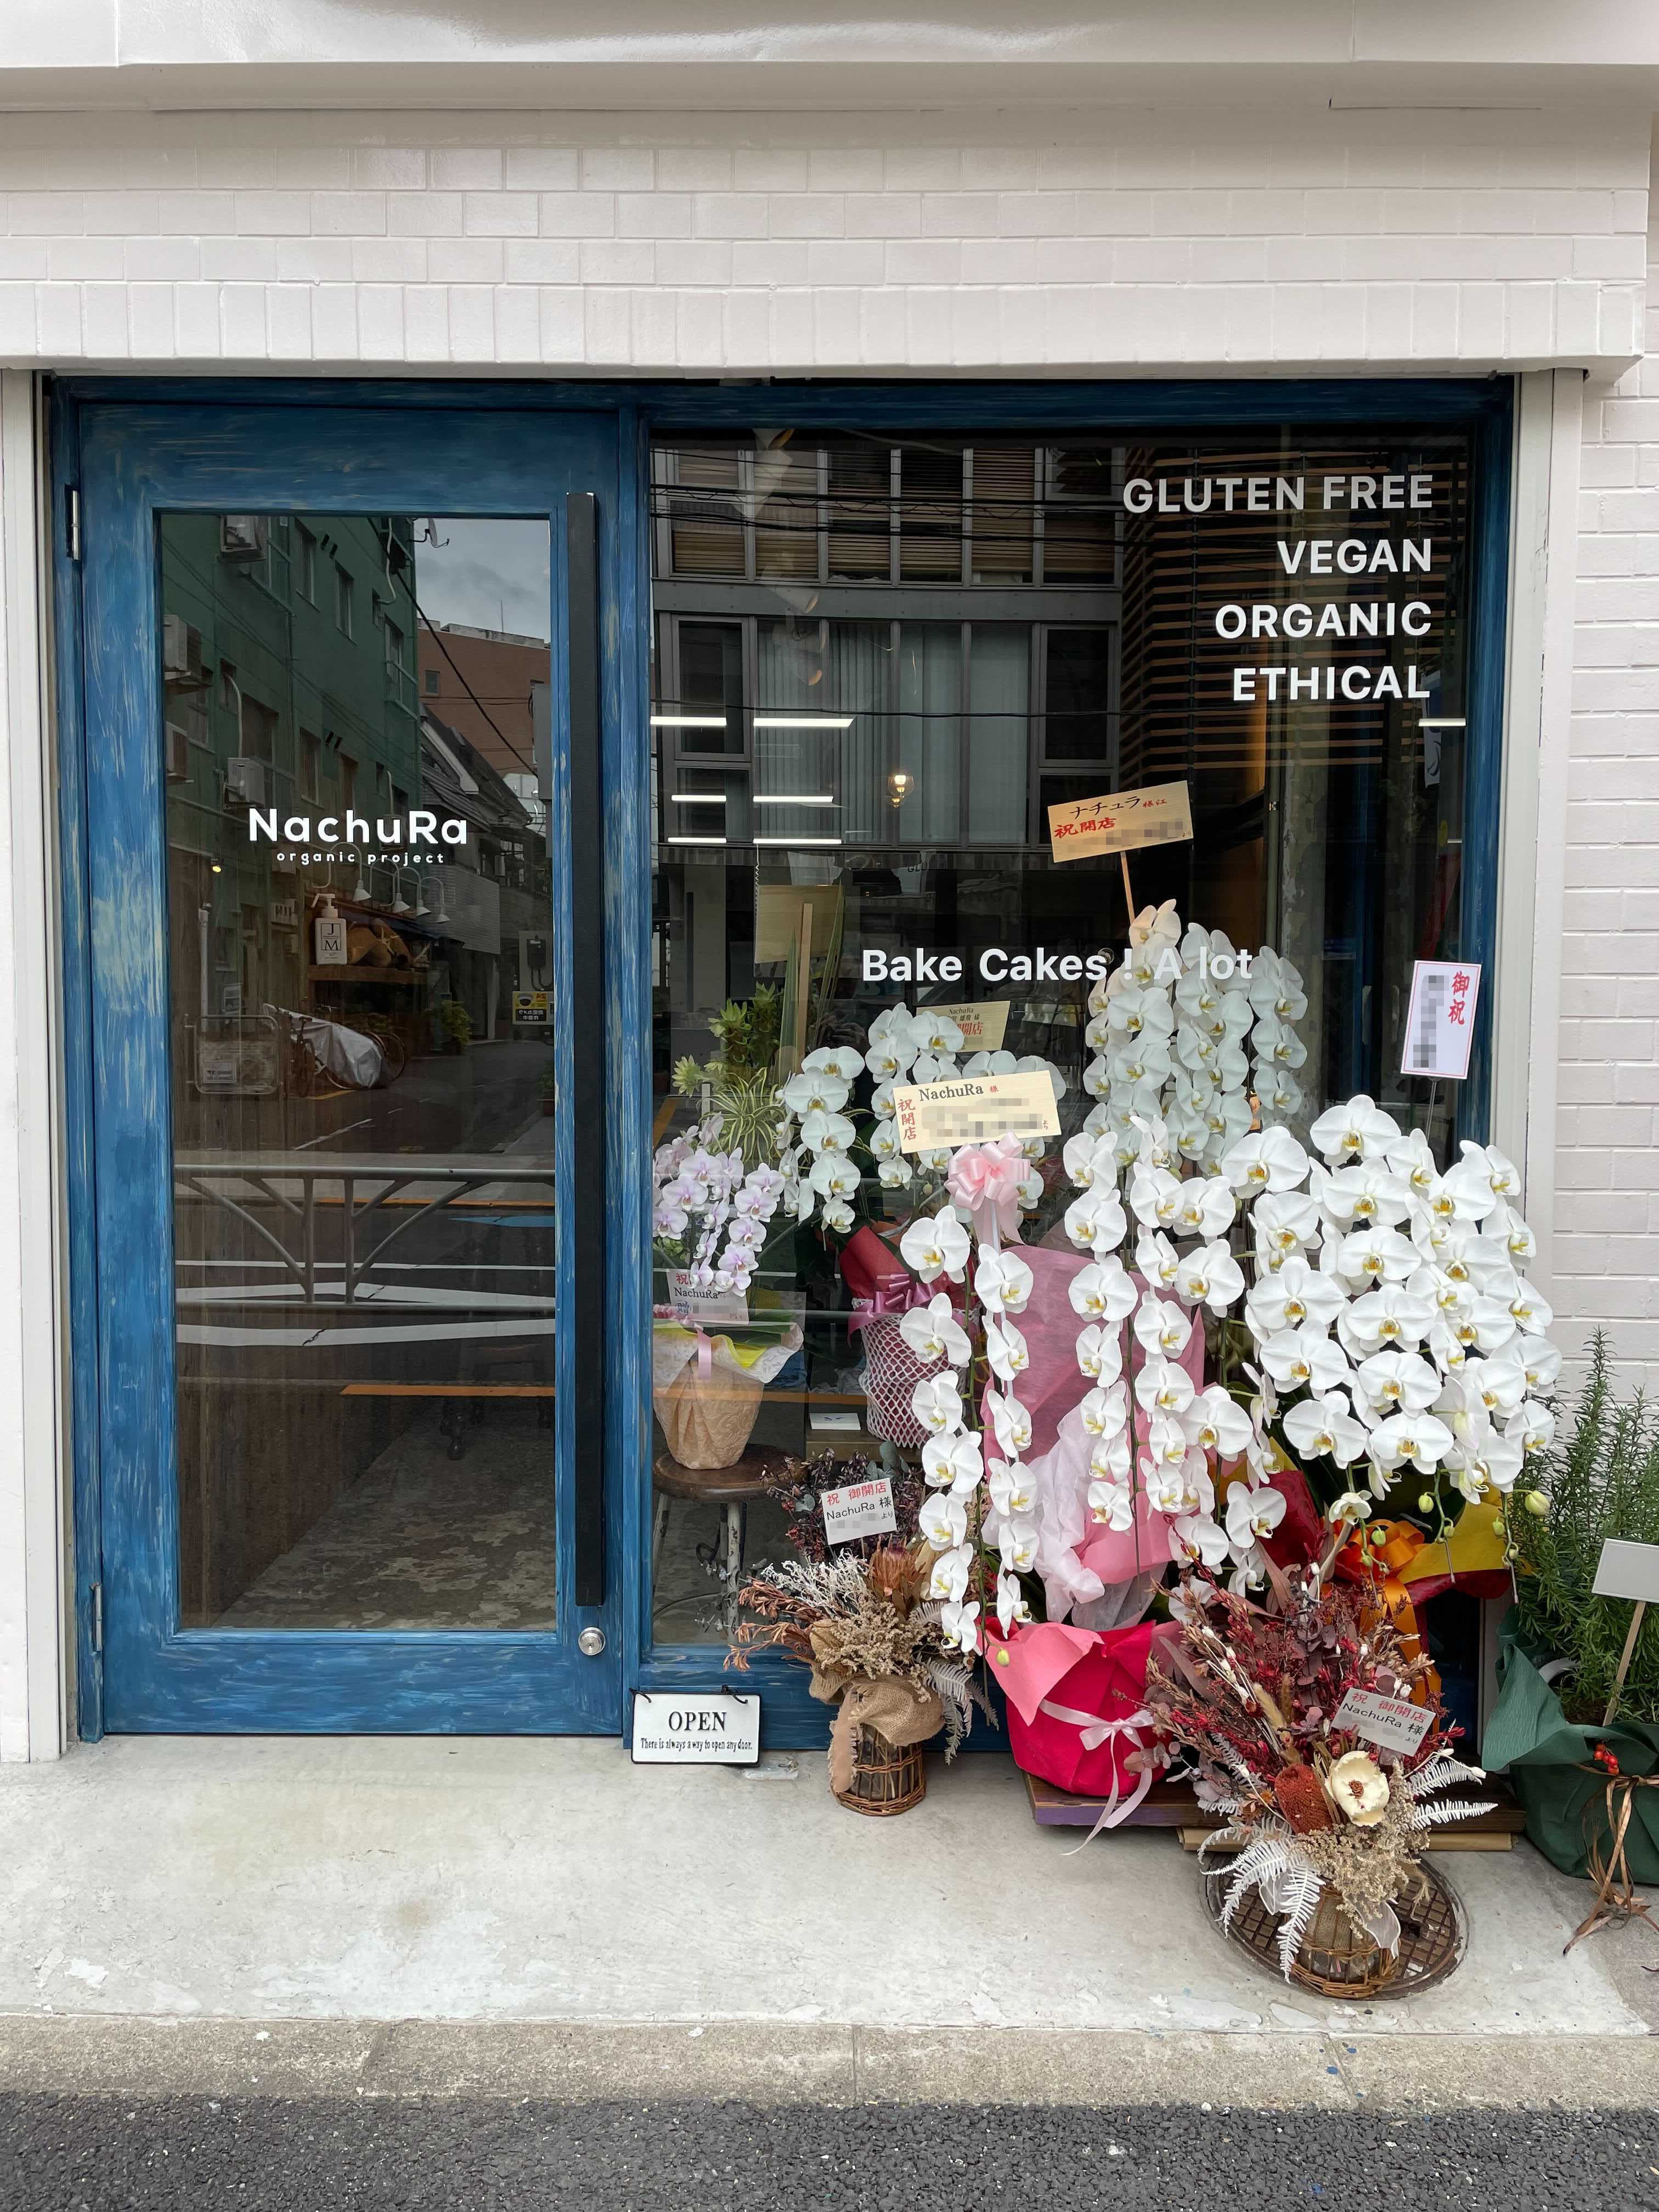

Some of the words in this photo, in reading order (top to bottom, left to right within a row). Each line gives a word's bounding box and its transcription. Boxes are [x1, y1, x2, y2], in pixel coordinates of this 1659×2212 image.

[1123, 477, 1305, 514] GLUTEN
[1323, 475, 1434, 510] FREE
[1277, 538, 1431, 574] VEGAN
[1215, 601, 1432, 639] ORGANIC
[1233, 665, 1431, 701] ETHICAL
[1069, 796, 1141, 820] ナチュラ
[249, 808, 467, 845] NachuRa
[1053, 817, 1117, 839] 祝開店
[276, 851, 356, 866] organic
[367, 853, 445, 867] project
[862, 947, 963, 981] Bake
[979, 947, 1107, 981] Cakes
[1153, 947, 1183, 980] A
[1199, 946, 1253, 980] lot
[1448, 970, 1471, 1025] 御祝
[957, 1022, 984, 1036] 開店
[918, 1083, 984, 1102] NachuRa
[898, 1098, 917, 1141] 祝開店
[674, 1287, 719, 1299] NachuRa
[826, 1493, 840, 1506] 祝
[848, 1481, 887, 1501] 御開店
[826, 1502, 875, 1521] NachuRa
[879, 1496, 892, 1509] 様
[881, 1510, 893, 1520] より
[1342, 1702, 1402, 1728] NachuRa
[1407, 1722, 1424, 1736] 様
[1351, 1692, 1368, 1705] 祝
[1378, 1699, 1428, 1724] 御開店
[668, 1711, 727, 1731] OPEN
[641, 1737, 658, 1749] There
[659, 1737, 664, 1750] is
[665, 1738, 686, 1752] always
[687, 1740, 691, 1750] a
[692, 1741, 703, 1752] way
[704, 1739, 710, 1750] to
[712, 1741, 725, 1752] open
[726, 1741, 737, 1753] any
[738, 1738, 753, 1750] door.
